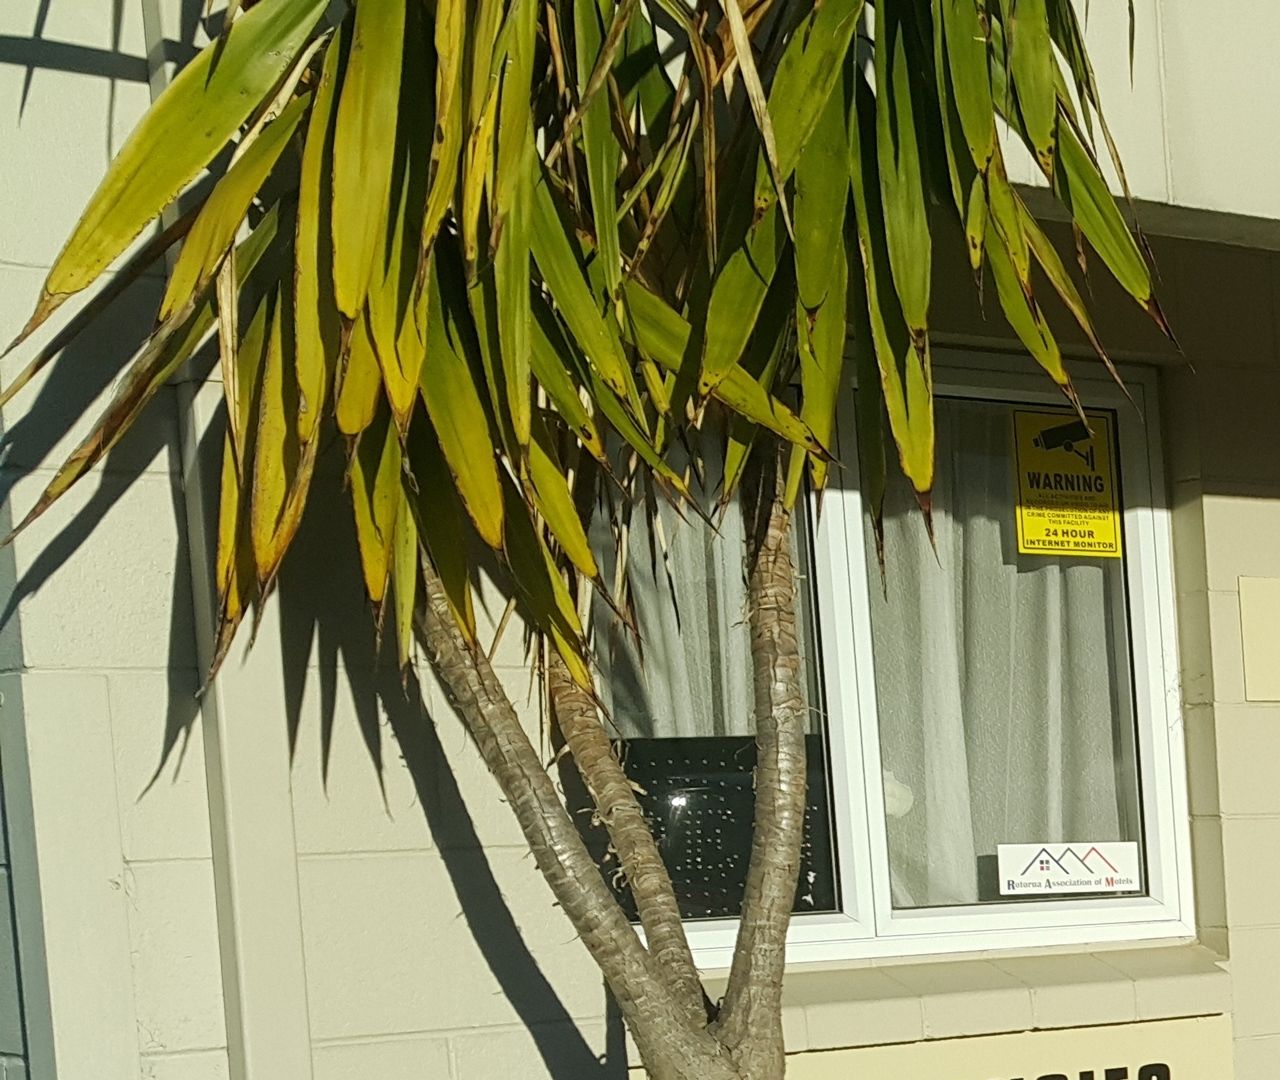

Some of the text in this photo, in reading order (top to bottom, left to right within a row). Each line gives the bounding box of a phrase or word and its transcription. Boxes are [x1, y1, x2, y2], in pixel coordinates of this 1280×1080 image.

[1027, 472, 1104, 493] WARNING
[1047, 512, 1082, 520] COMMITTED
[1045, 528, 1094, 539] 24 HOUR
[1026, 539, 1114, 549] INTERNET MONITOR
[1007, 877, 1133, 890] Rotorua Association of Motels
